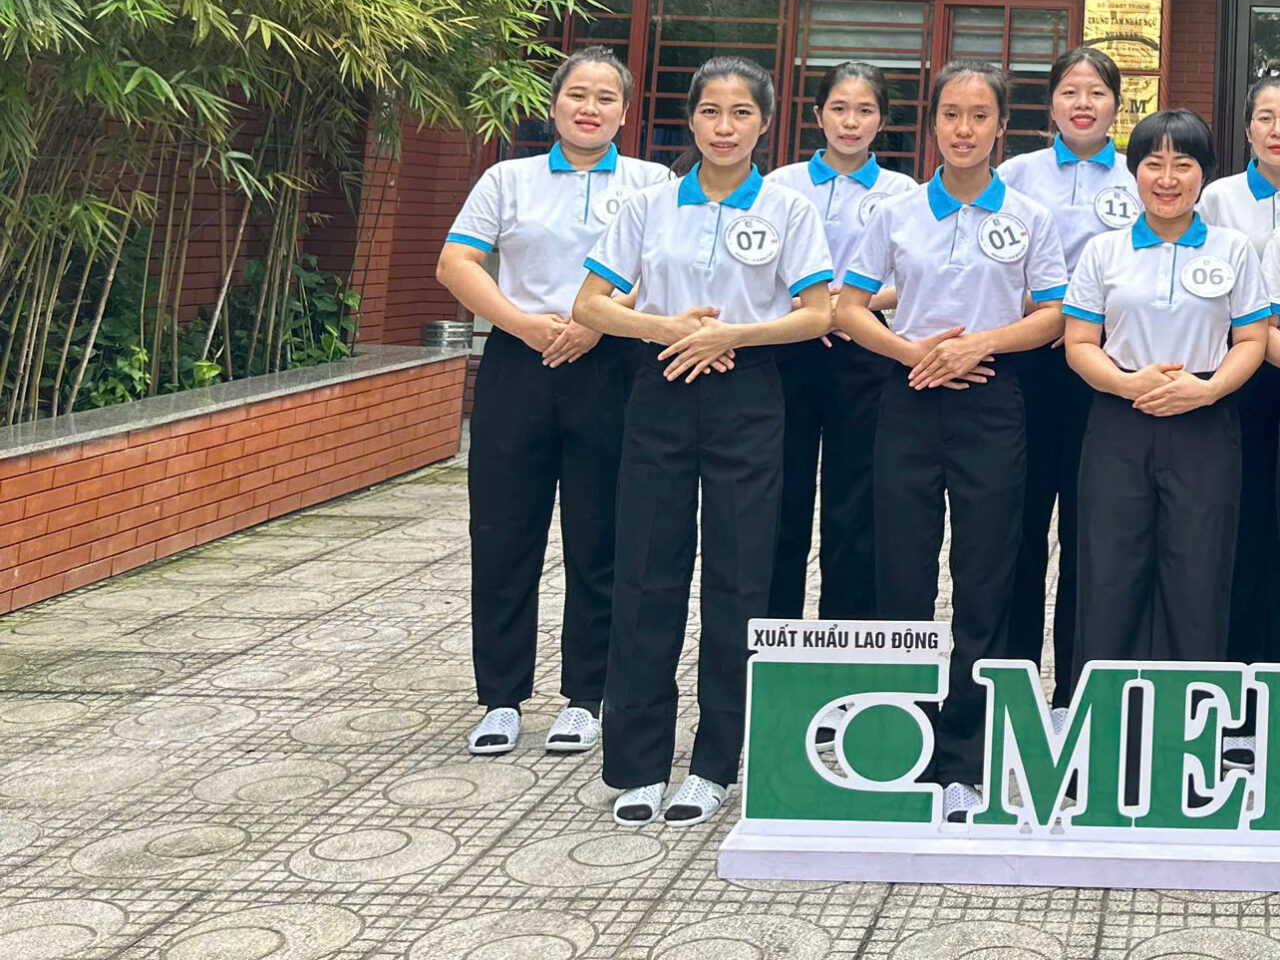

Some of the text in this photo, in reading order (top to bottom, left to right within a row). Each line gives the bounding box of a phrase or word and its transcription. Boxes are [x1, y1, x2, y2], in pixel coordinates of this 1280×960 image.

[1105, 200, 1131, 219] 11
[736, 230, 767, 251] 07
[988, 225, 1021, 250] 01
[1192, 268, 1224, 285] 06
[753, 623, 939, 653] XUẤT KHẨU LAO ĐỘNG
